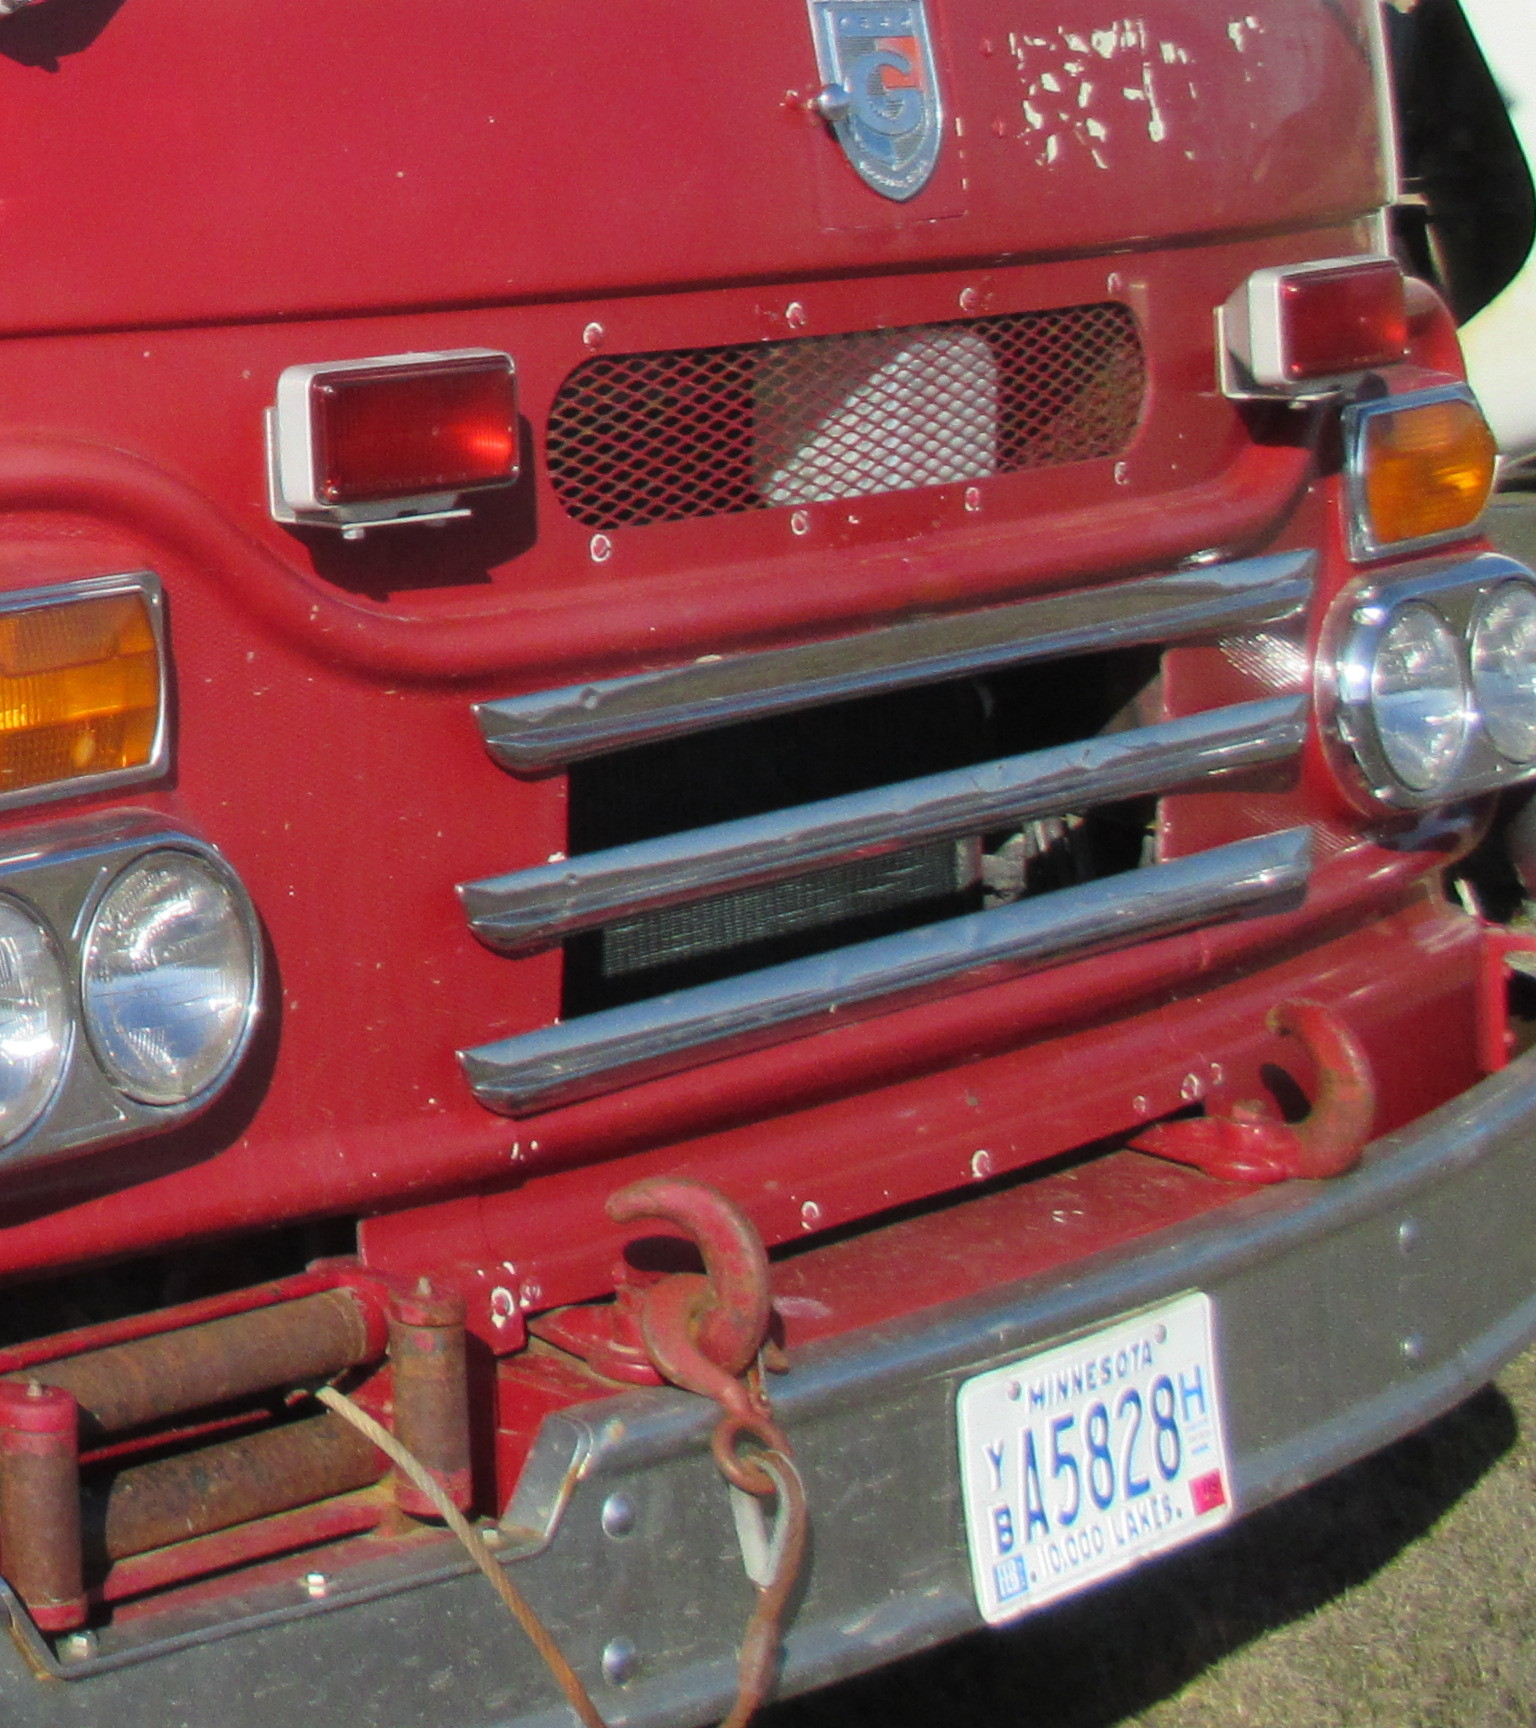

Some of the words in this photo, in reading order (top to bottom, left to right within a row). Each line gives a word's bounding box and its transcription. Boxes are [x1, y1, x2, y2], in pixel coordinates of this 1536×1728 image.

[1027, 1339, 1153, 1411] MINNESOTA
[1020, 1372, 1182, 1544] A5828
[1109, 1492, 1173, 1547] LAKES
